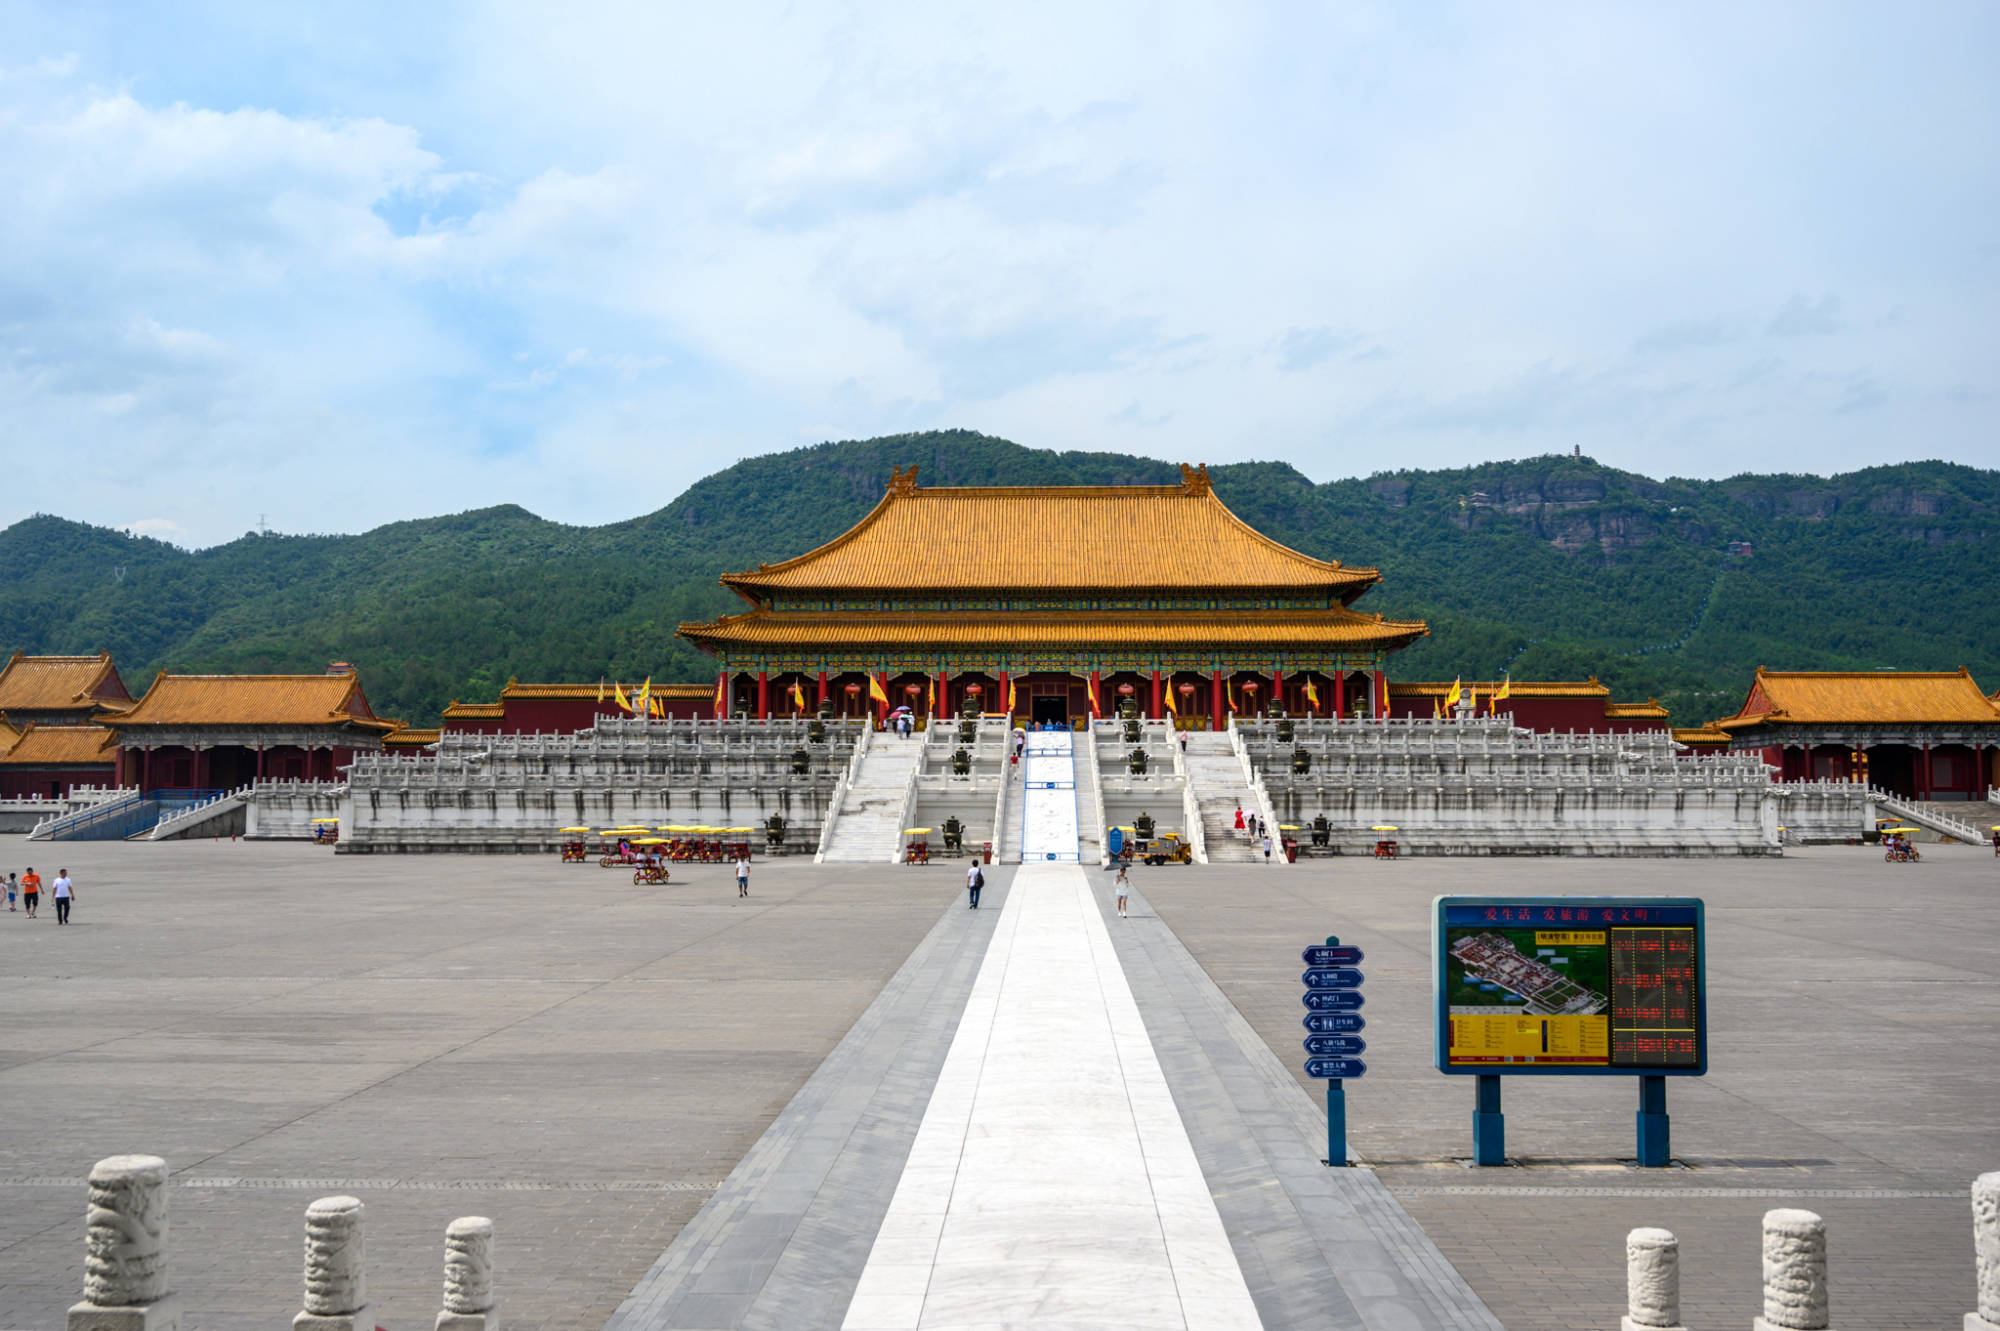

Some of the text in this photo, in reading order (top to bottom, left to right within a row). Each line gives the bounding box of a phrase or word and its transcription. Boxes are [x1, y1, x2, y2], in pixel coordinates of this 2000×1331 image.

[1485, 908, 1531, 920] 爱生活
[1543, 908, 1589, 920] 爱旅游
